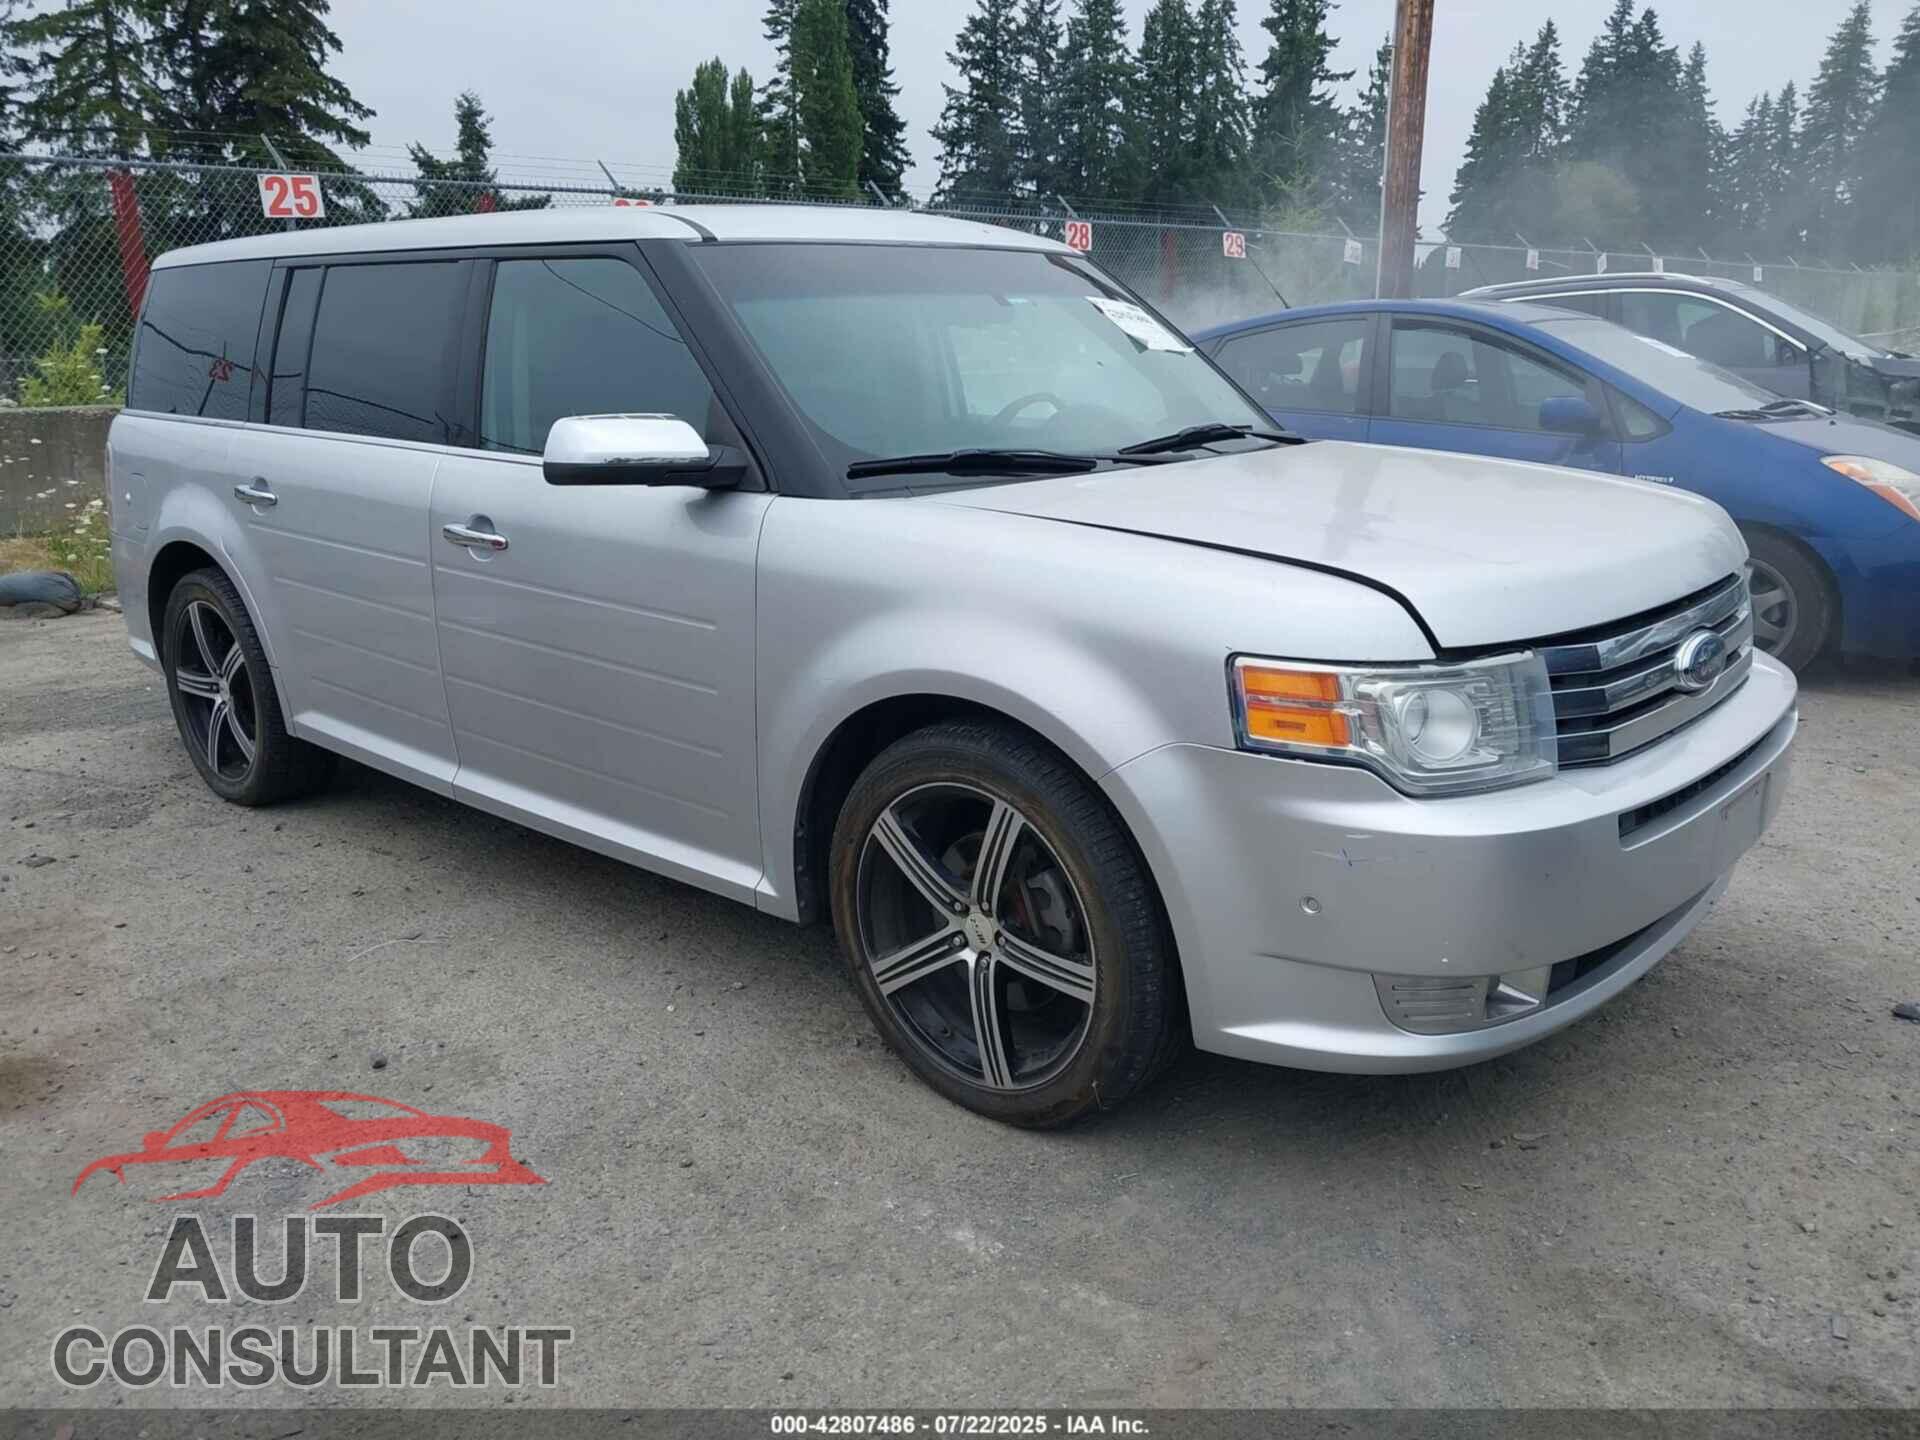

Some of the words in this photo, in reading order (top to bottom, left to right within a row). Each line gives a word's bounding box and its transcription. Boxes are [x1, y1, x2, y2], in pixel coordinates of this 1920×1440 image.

[264, 176, 318, 216] 25
[1067, 222, 1090, 250] 28
[1225, 234, 1244, 257] 29
